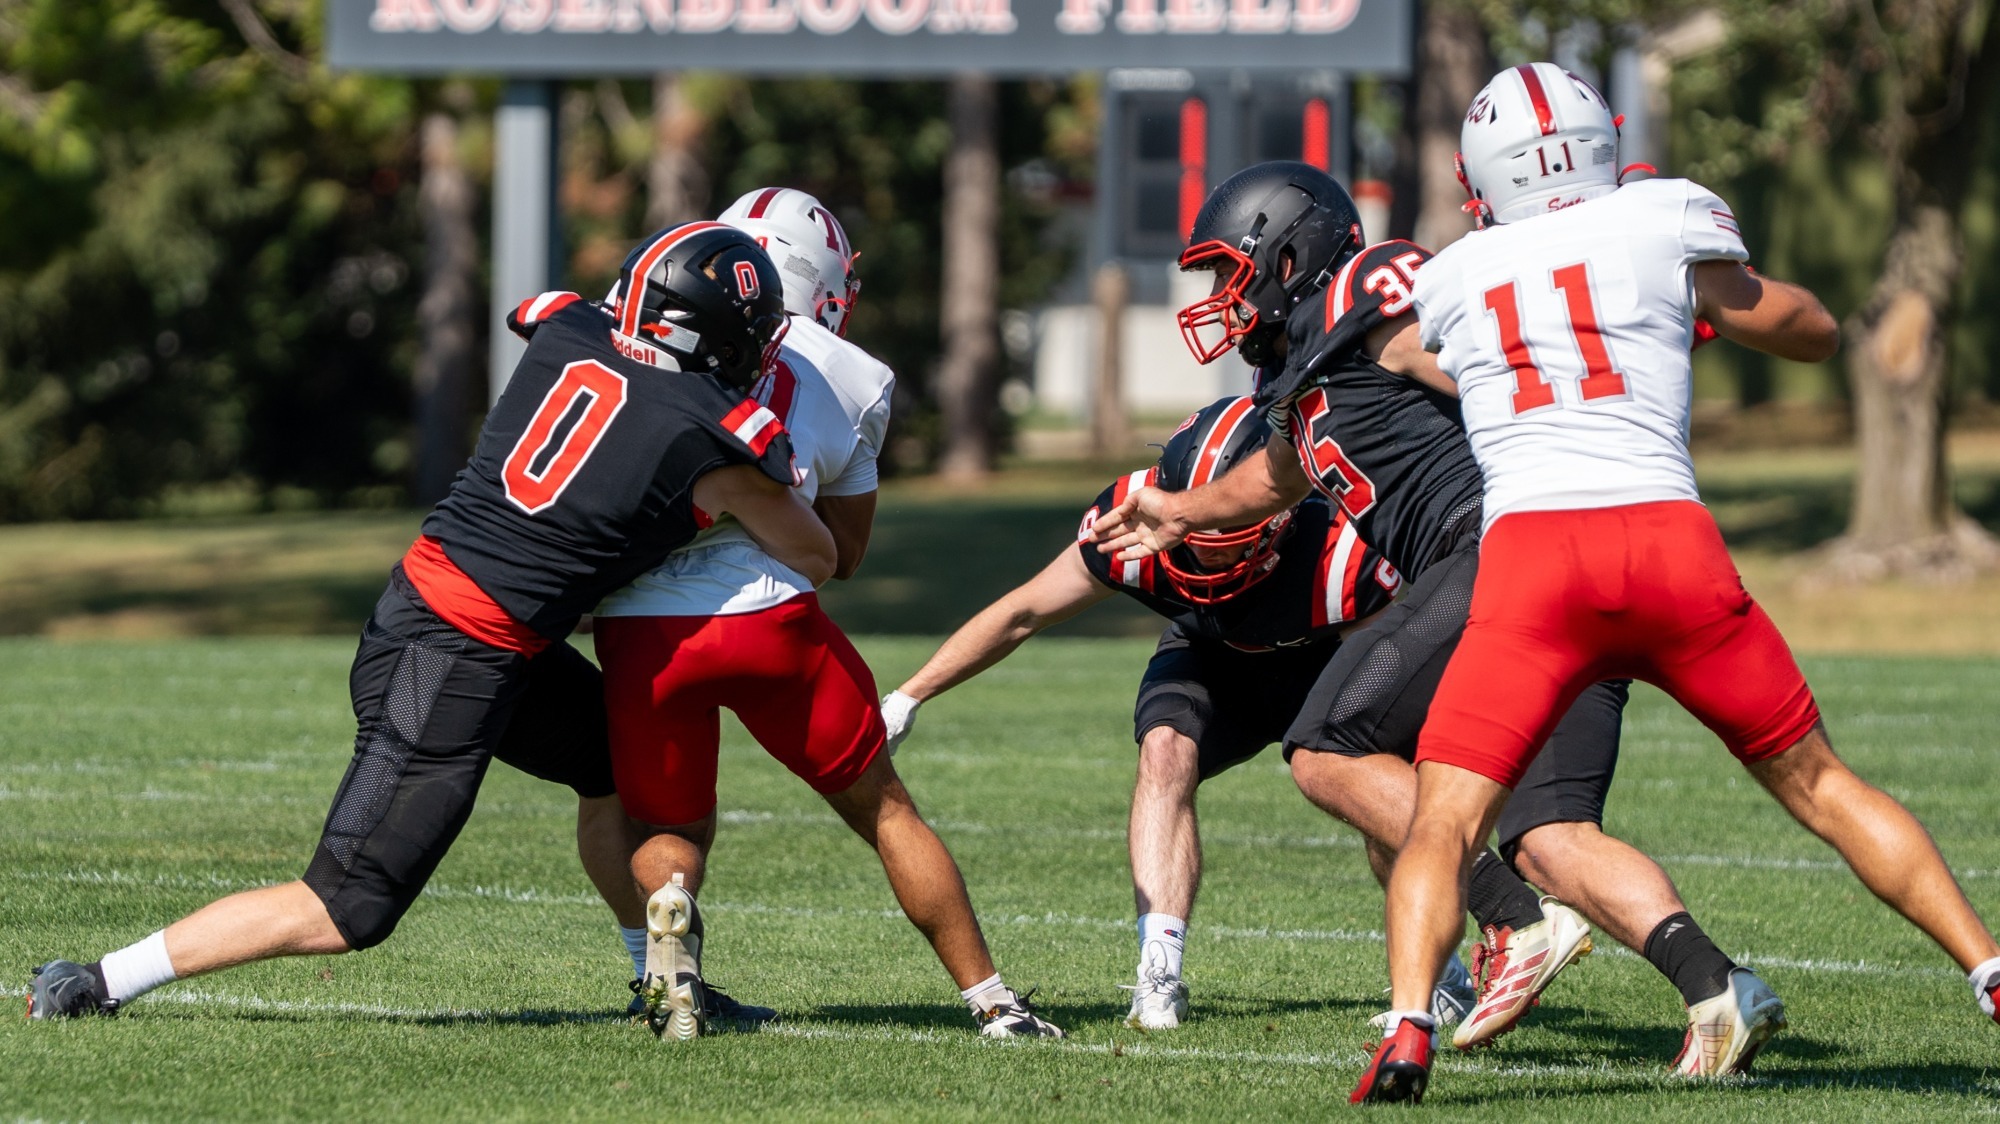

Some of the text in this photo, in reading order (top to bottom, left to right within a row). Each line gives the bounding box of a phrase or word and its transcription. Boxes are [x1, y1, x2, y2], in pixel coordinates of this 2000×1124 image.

[1536, 141, 1576, 177] 11
[1363, 250, 1424, 317] 35
[1480, 258, 1634, 419] 11
[501, 359, 628, 514] 0
